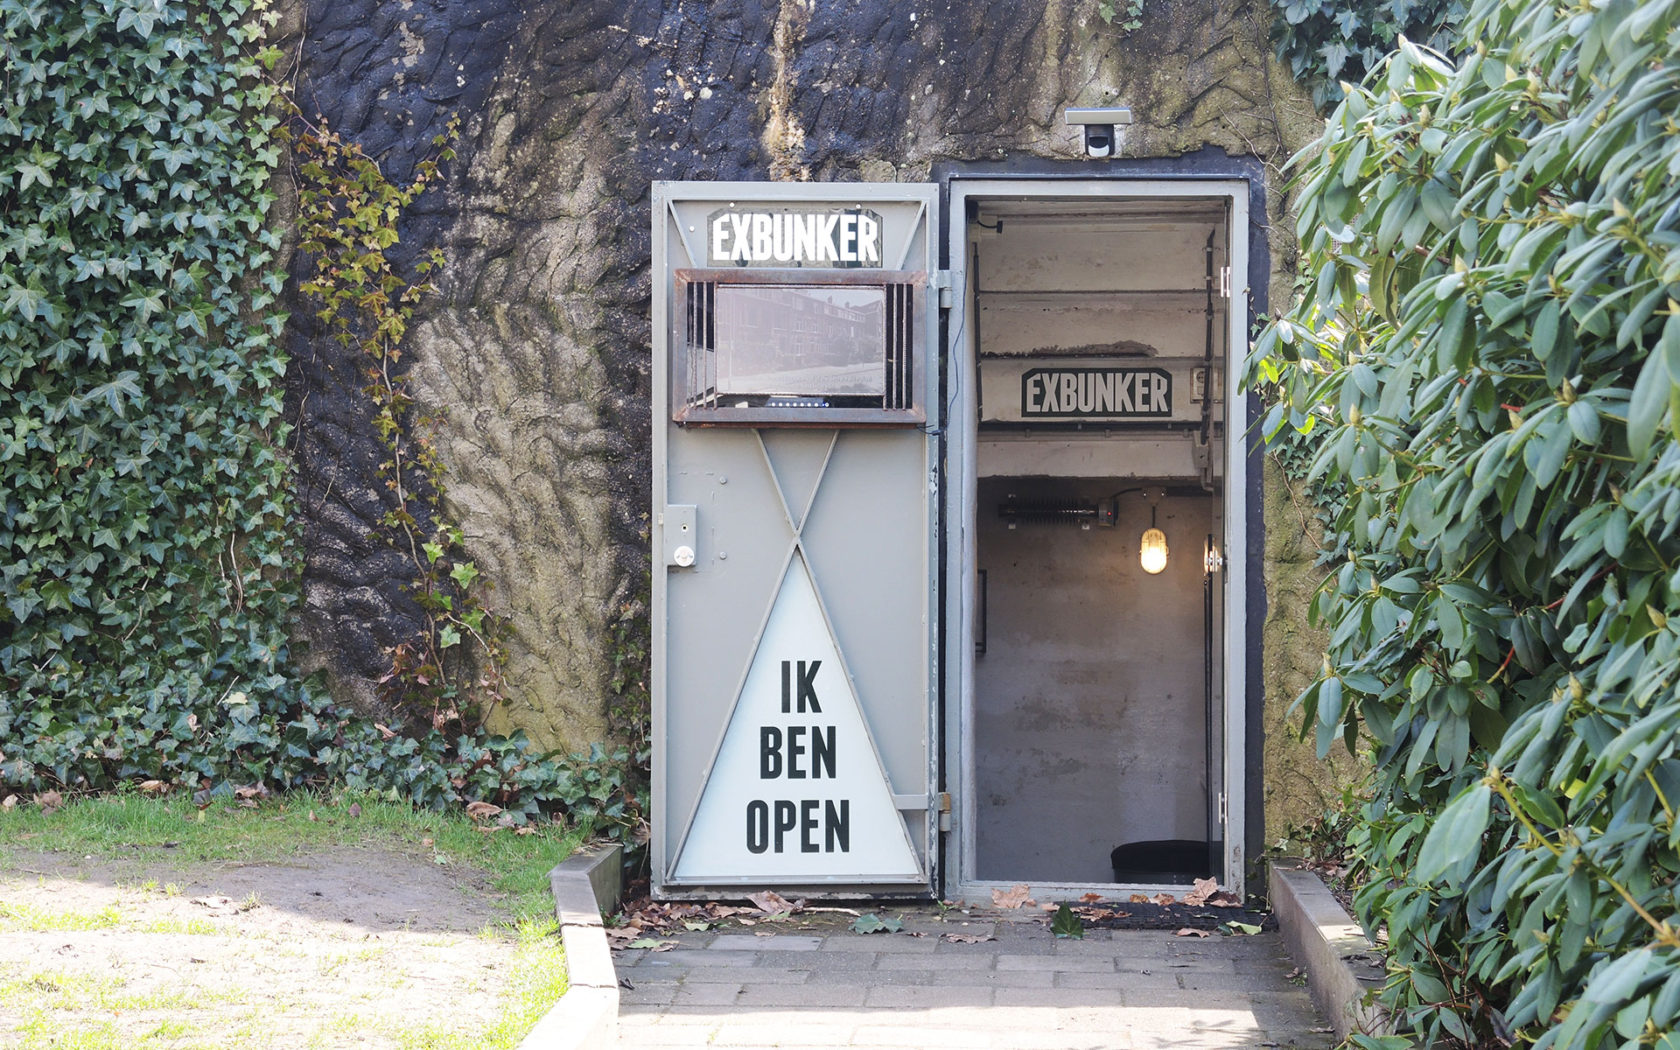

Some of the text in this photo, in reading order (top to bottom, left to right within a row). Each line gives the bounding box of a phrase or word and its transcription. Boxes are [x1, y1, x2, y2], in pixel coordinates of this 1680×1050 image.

[712, 213, 879, 262] EXBUNKER
[1026, 372, 1169, 413] EXBUNKER
[781, 660, 822, 713] IK
[760, 726, 836, 780] BEN
[746, 799, 850, 854] OPEN
